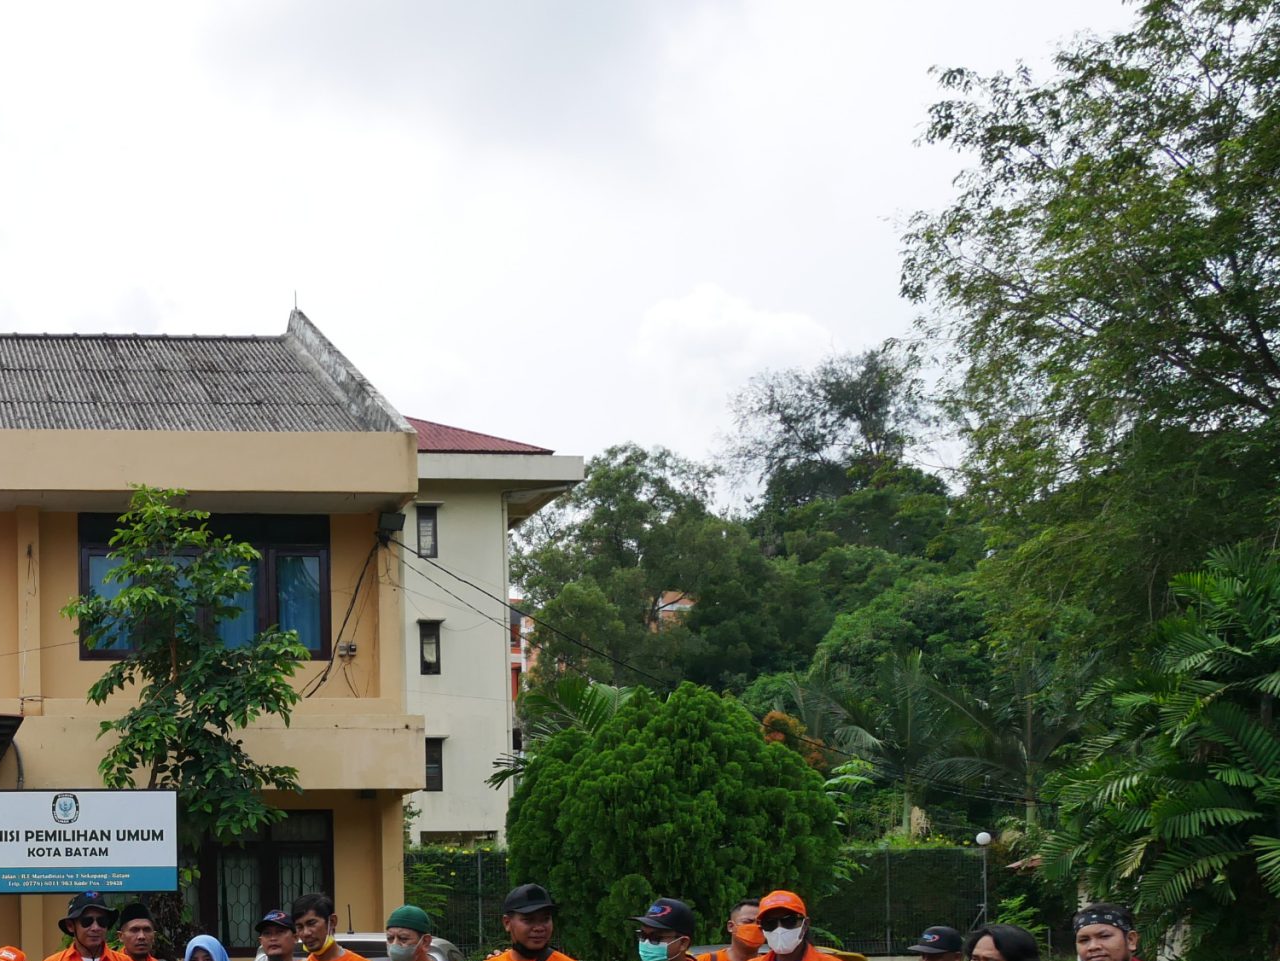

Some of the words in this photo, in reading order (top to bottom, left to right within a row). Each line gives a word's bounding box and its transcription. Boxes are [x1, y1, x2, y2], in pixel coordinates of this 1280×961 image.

[24, 829, 111, 842] PEMILIHAN
[116, 829, 164, 841] UMUM
[27, 847, 62, 857] KOTA
[65, 847, 109, 857] BATAM
